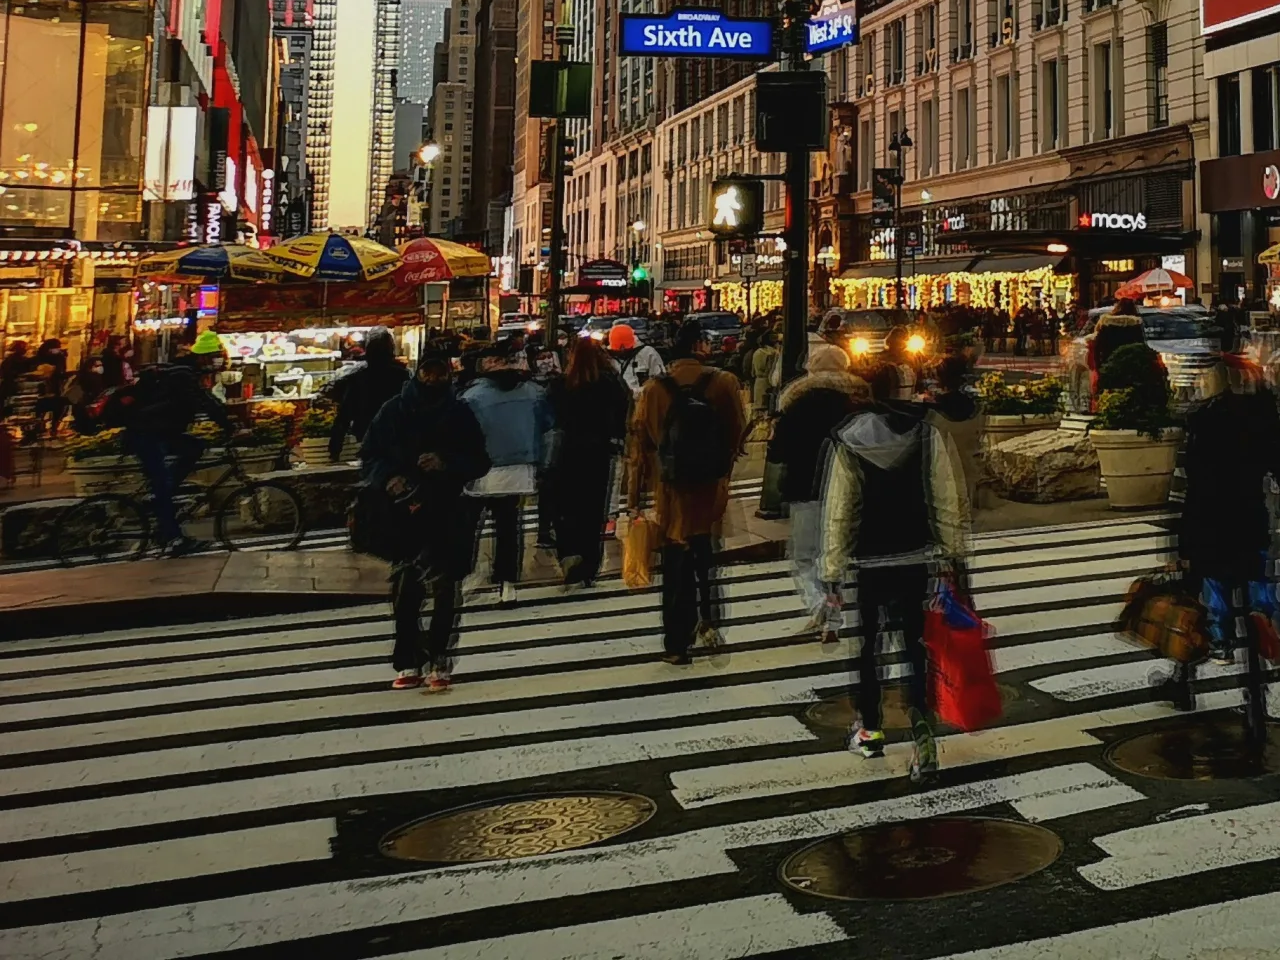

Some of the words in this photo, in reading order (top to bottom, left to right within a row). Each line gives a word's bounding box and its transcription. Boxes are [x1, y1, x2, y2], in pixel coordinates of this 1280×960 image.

[677, 13, 721, 22] BROADWAY
[643, 25, 702, 47] Sixth
[708, 27, 753, 49] Ave
[214, 150, 226, 190] verizon
[280, 182, 289, 216] KAY
[1091, 212, 1147, 232] macy's
